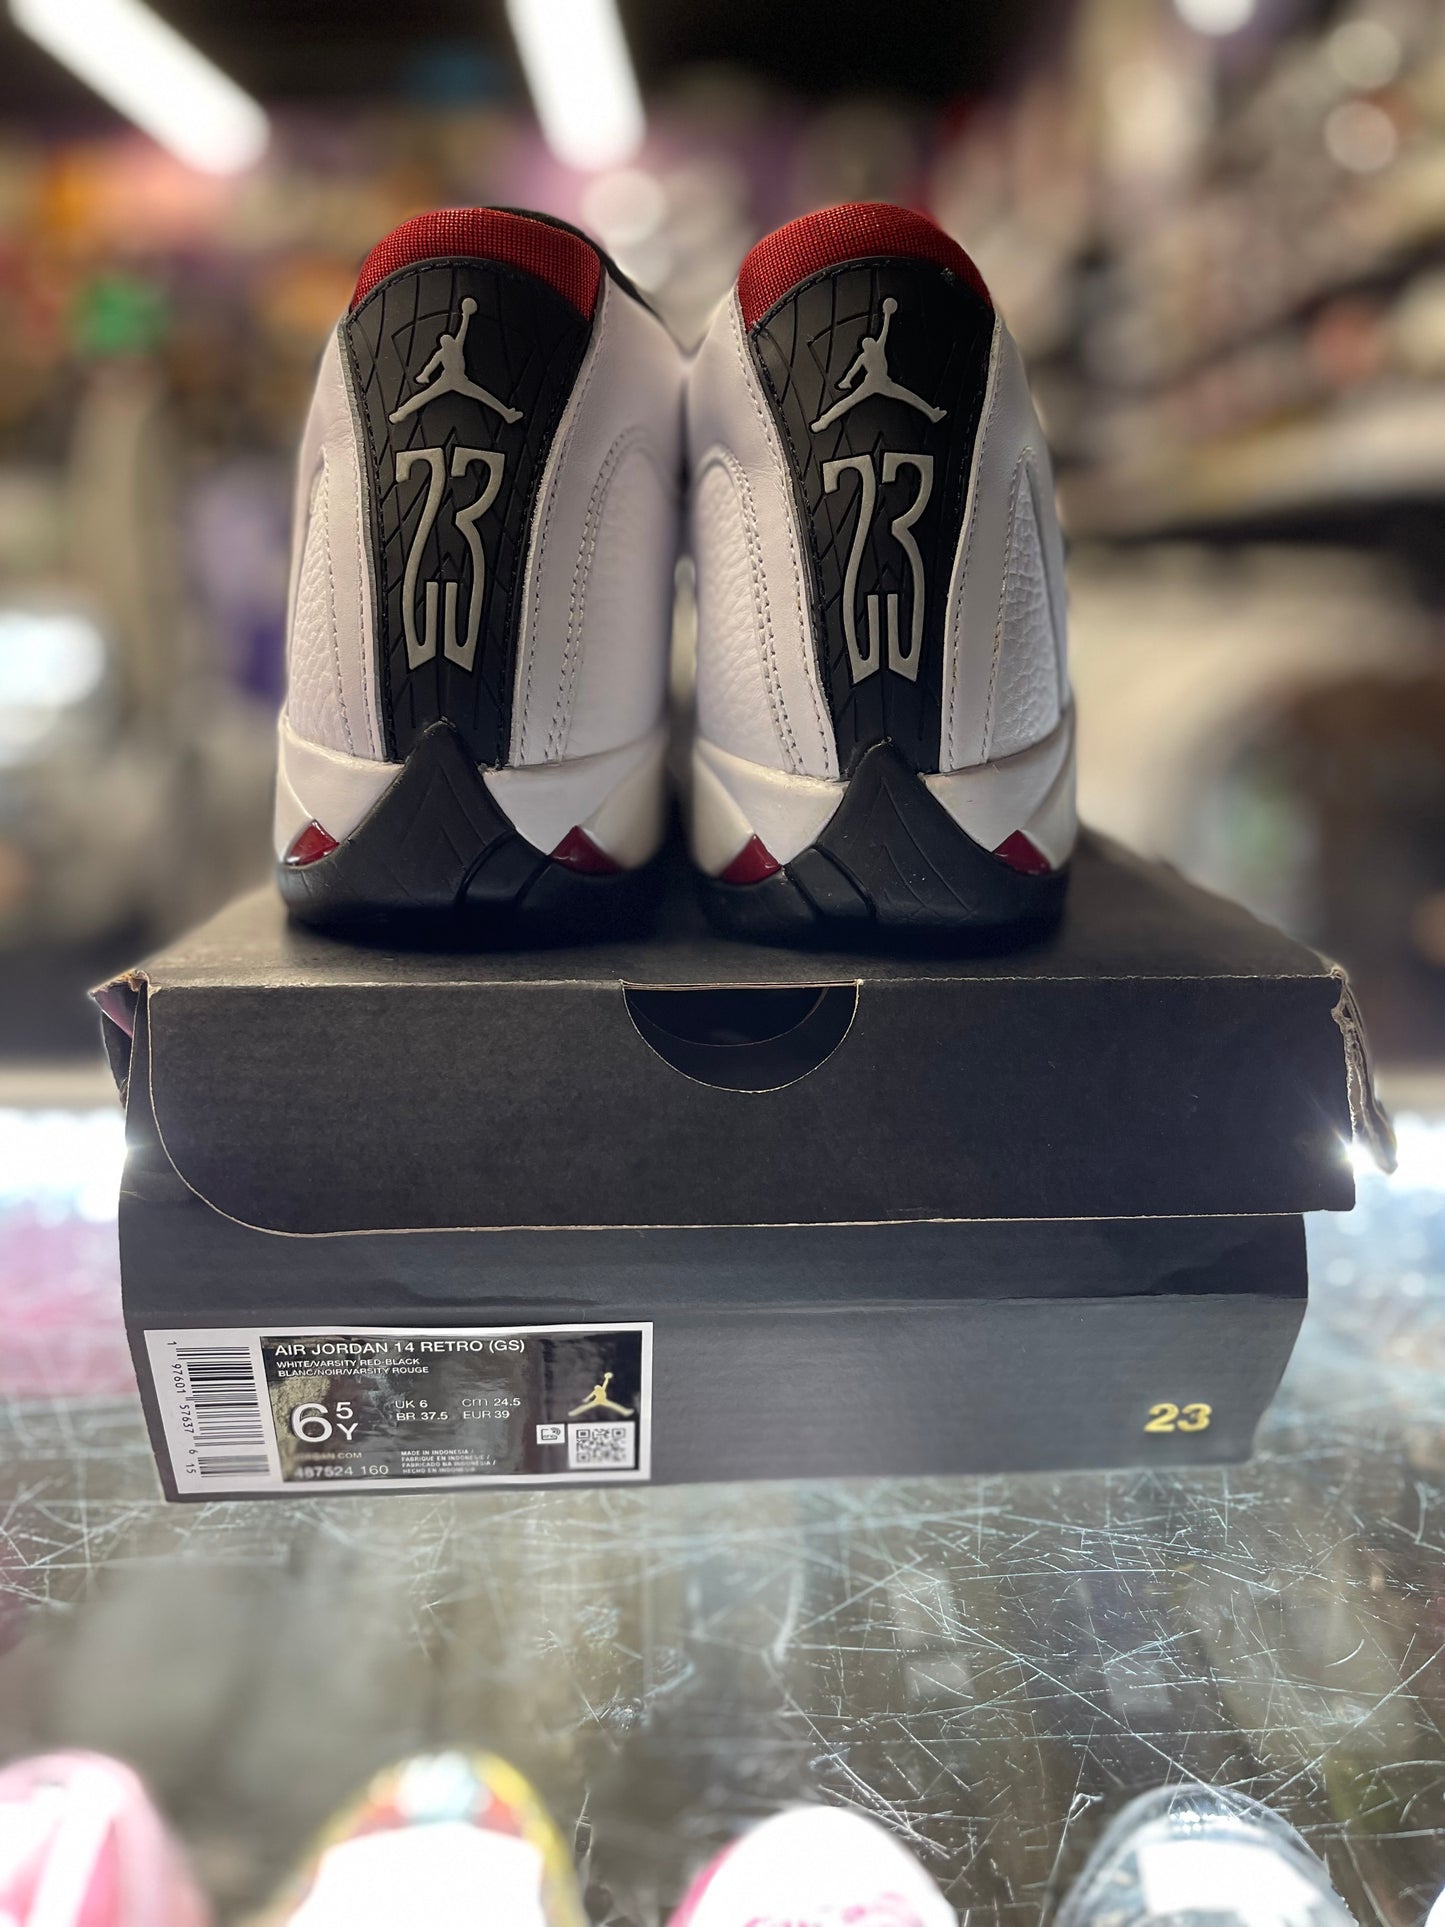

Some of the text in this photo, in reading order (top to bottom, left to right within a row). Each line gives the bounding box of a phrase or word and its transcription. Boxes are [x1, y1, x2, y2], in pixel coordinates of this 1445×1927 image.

[396, 447, 505, 671] 23
[823, 452, 934, 683] 23
[275, 1339, 525, 1356] AIR JORDAN 14 RETRO (GS)
[276, 1358, 420, 1369] WHITE/VARSITY RED-BLACK
[278, 1366, 429, 1377] BLANC/NOIR/VARSITY ROUGE
[171, 1363, 186, 1395] 97601
[395, 1399, 428, 1409] UK 6
[493, 1397, 521, 1407] 24.5
[179, 1404, 195, 1434] 57637
[396, 1411, 448, 1421] BR 37.5
[463, 1409, 510, 1419] EUR 39
[1143, 1402, 1212, 1432] 23
[293, 1402, 353, 1442] 6 5
[337, 1423, 358, 1441] Y
[186, 1463, 197, 1475] 15
[361, 1464, 389, 1476] 160
